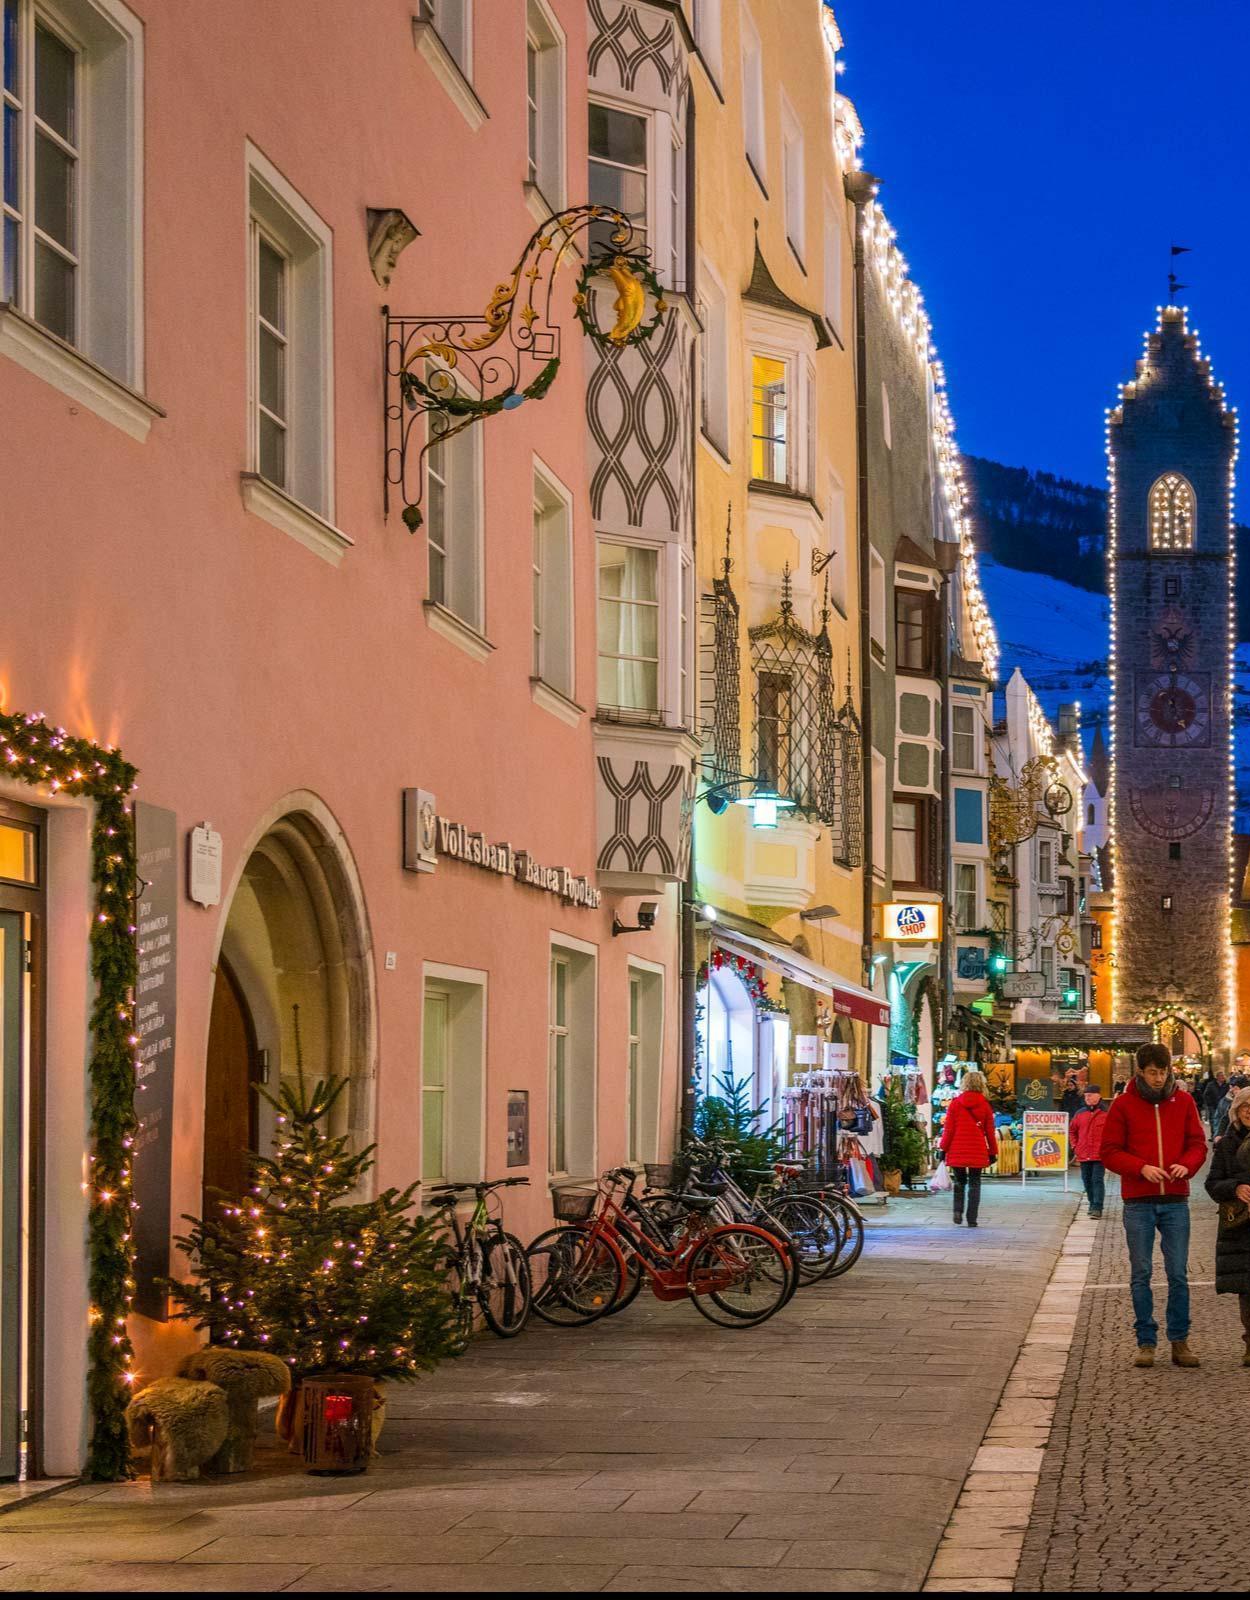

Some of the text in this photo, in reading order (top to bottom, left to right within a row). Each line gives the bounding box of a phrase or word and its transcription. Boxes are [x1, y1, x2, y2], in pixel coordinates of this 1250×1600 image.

[438, 815, 516, 877] Volksbank
[525, 853, 560, 893] Banca
[562, 866, 601, 910] Popolare
[900, 922, 926, 936] SHOP
[1011, 982, 1038, 992] POST
[1025, 1114, 1066, 1124] DISCOUNT
[1035, 1153, 1061, 1168] SHOP
